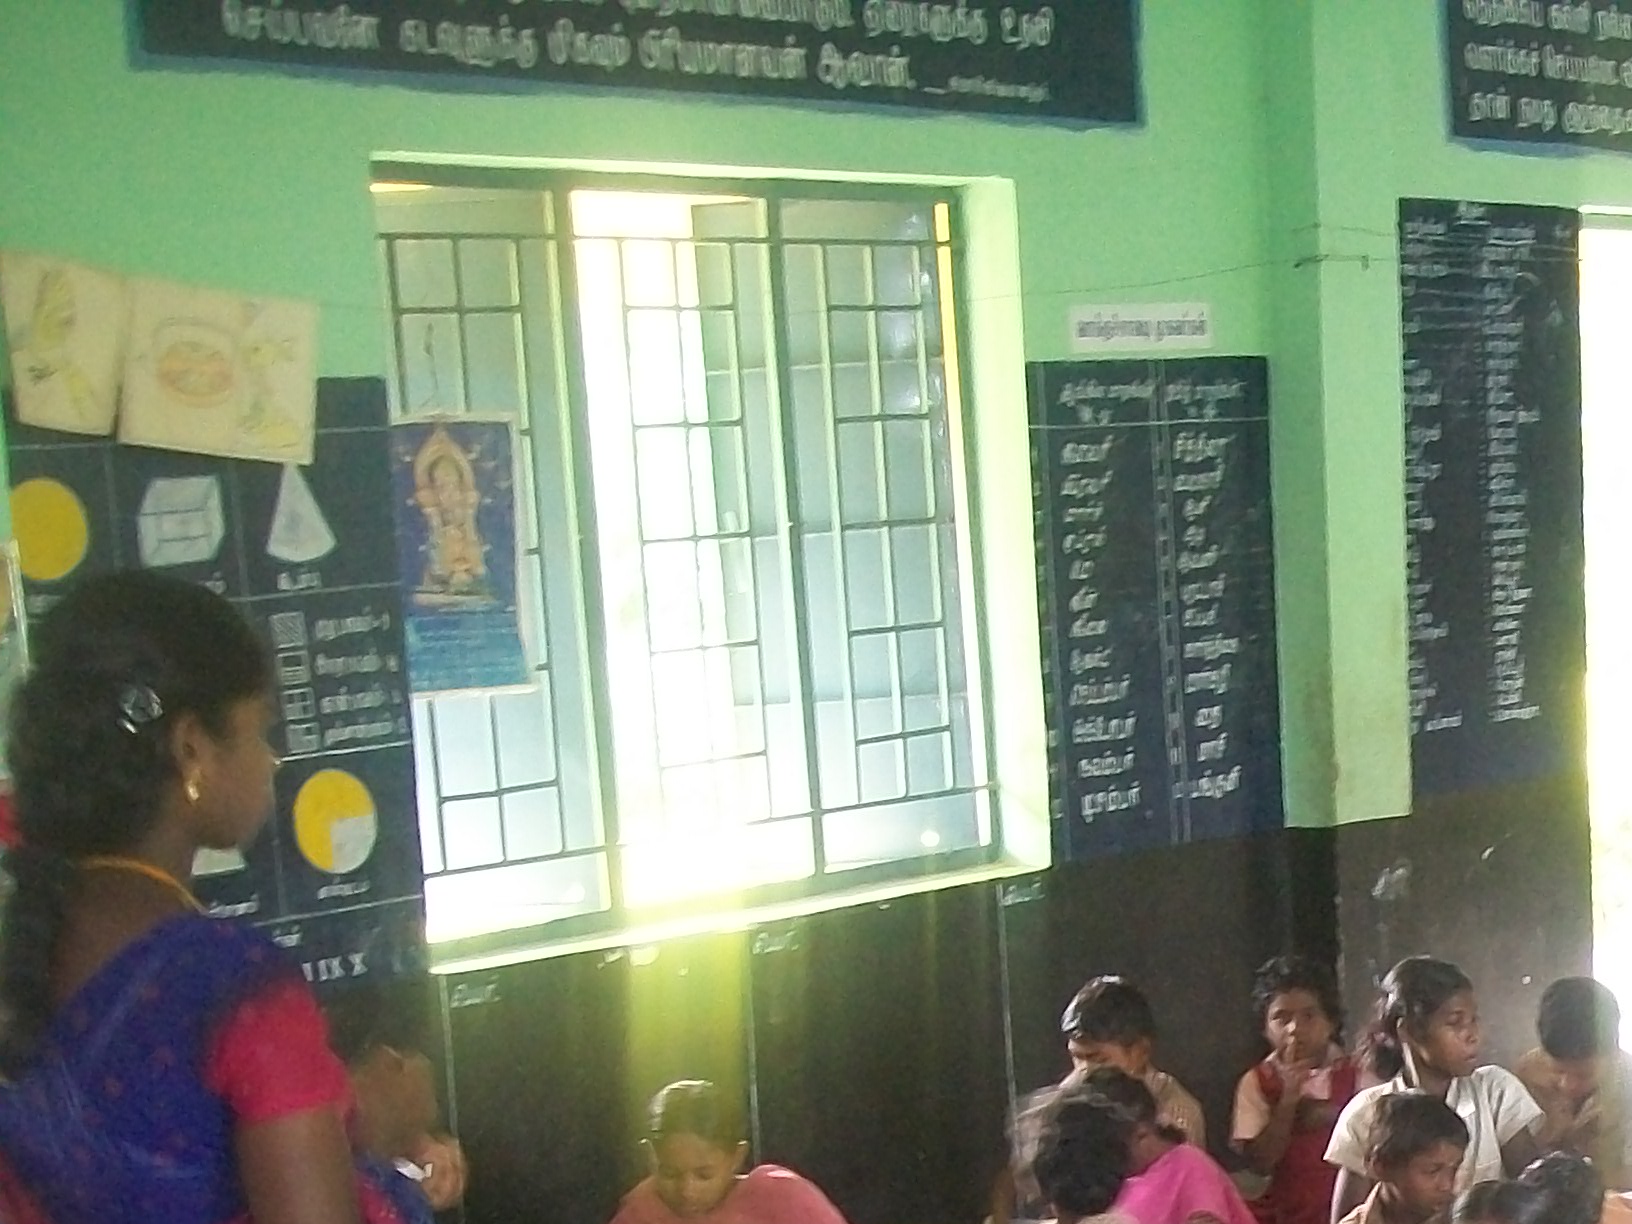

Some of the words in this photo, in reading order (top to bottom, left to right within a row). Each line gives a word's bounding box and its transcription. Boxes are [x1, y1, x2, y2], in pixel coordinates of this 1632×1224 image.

[400, 15, 538, 68] கடவுளுக்கு
[546, 17, 632, 71] மிகவும்
[639, 26, 807, 79] பிரியமானவன்
[1000, 7, 1054, 50] உதவி
